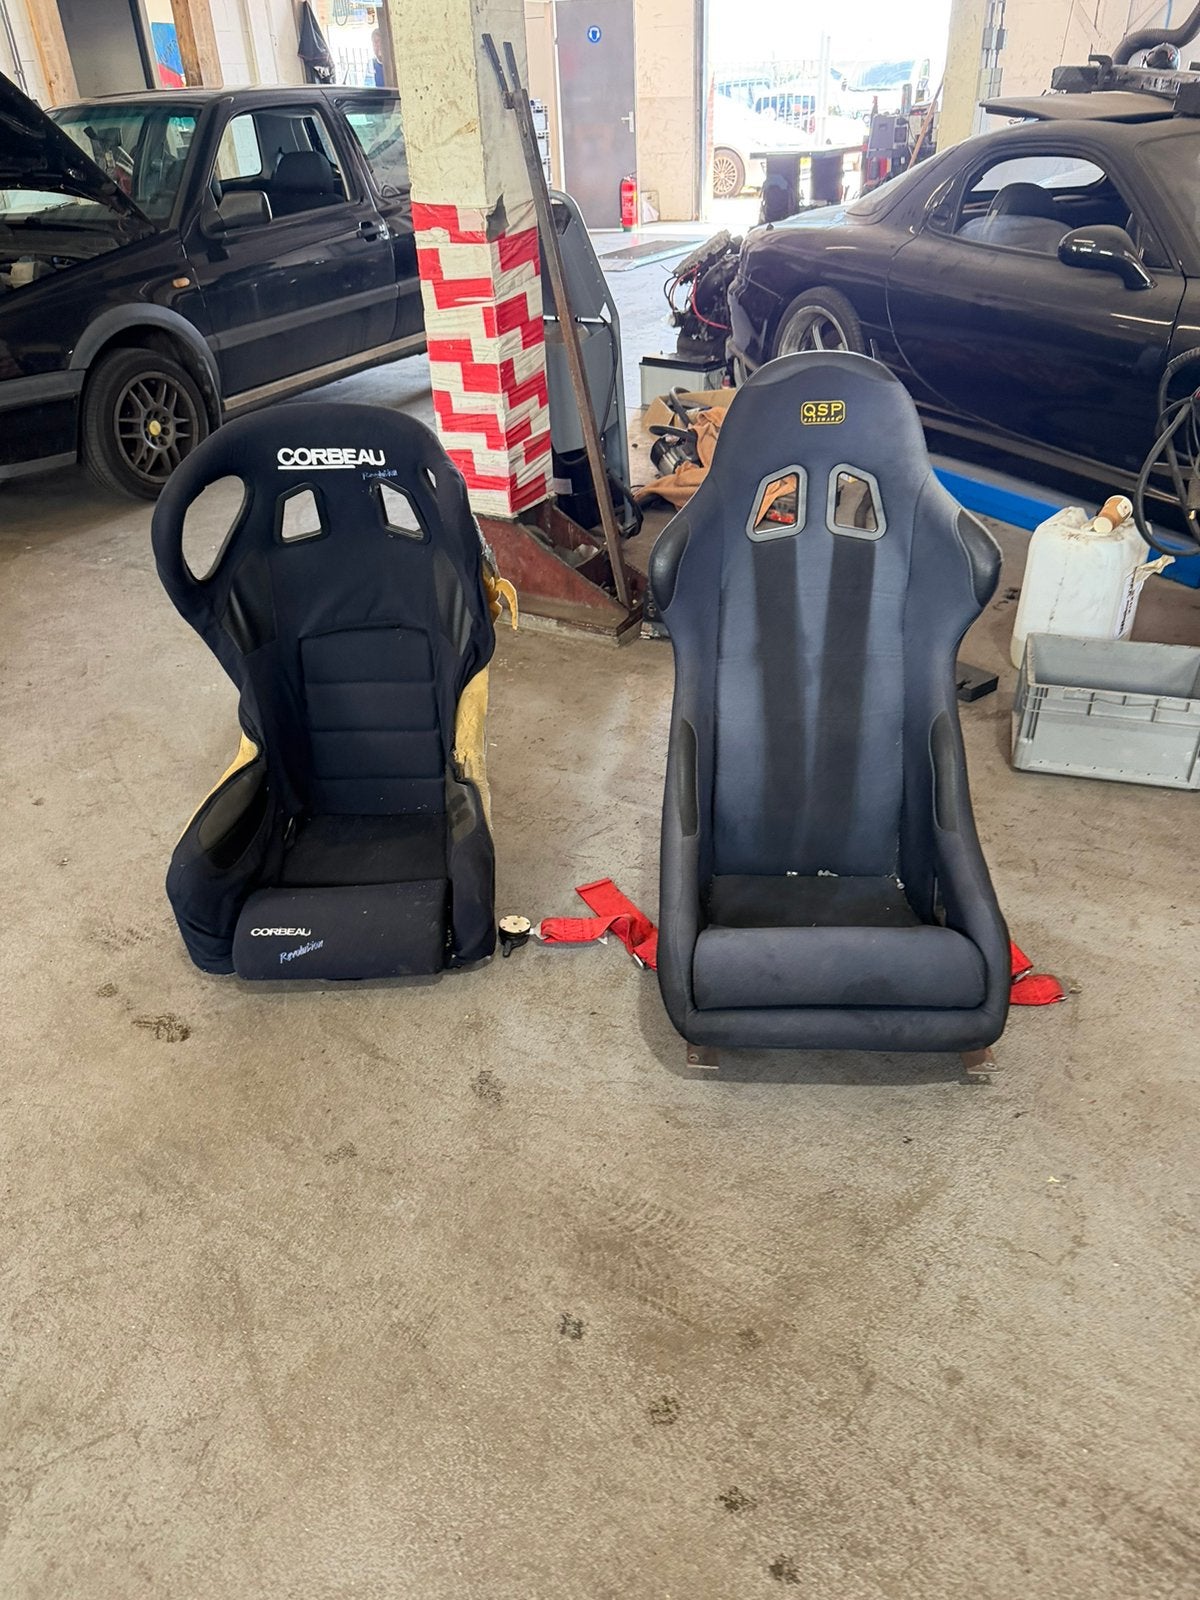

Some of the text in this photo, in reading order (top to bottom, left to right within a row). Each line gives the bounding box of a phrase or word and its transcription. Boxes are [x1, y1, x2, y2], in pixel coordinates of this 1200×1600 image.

[803, 403, 842, 416] QSP
[277, 447, 386, 466] CORBEAU
[250, 927, 312, 936] CORBEAU
